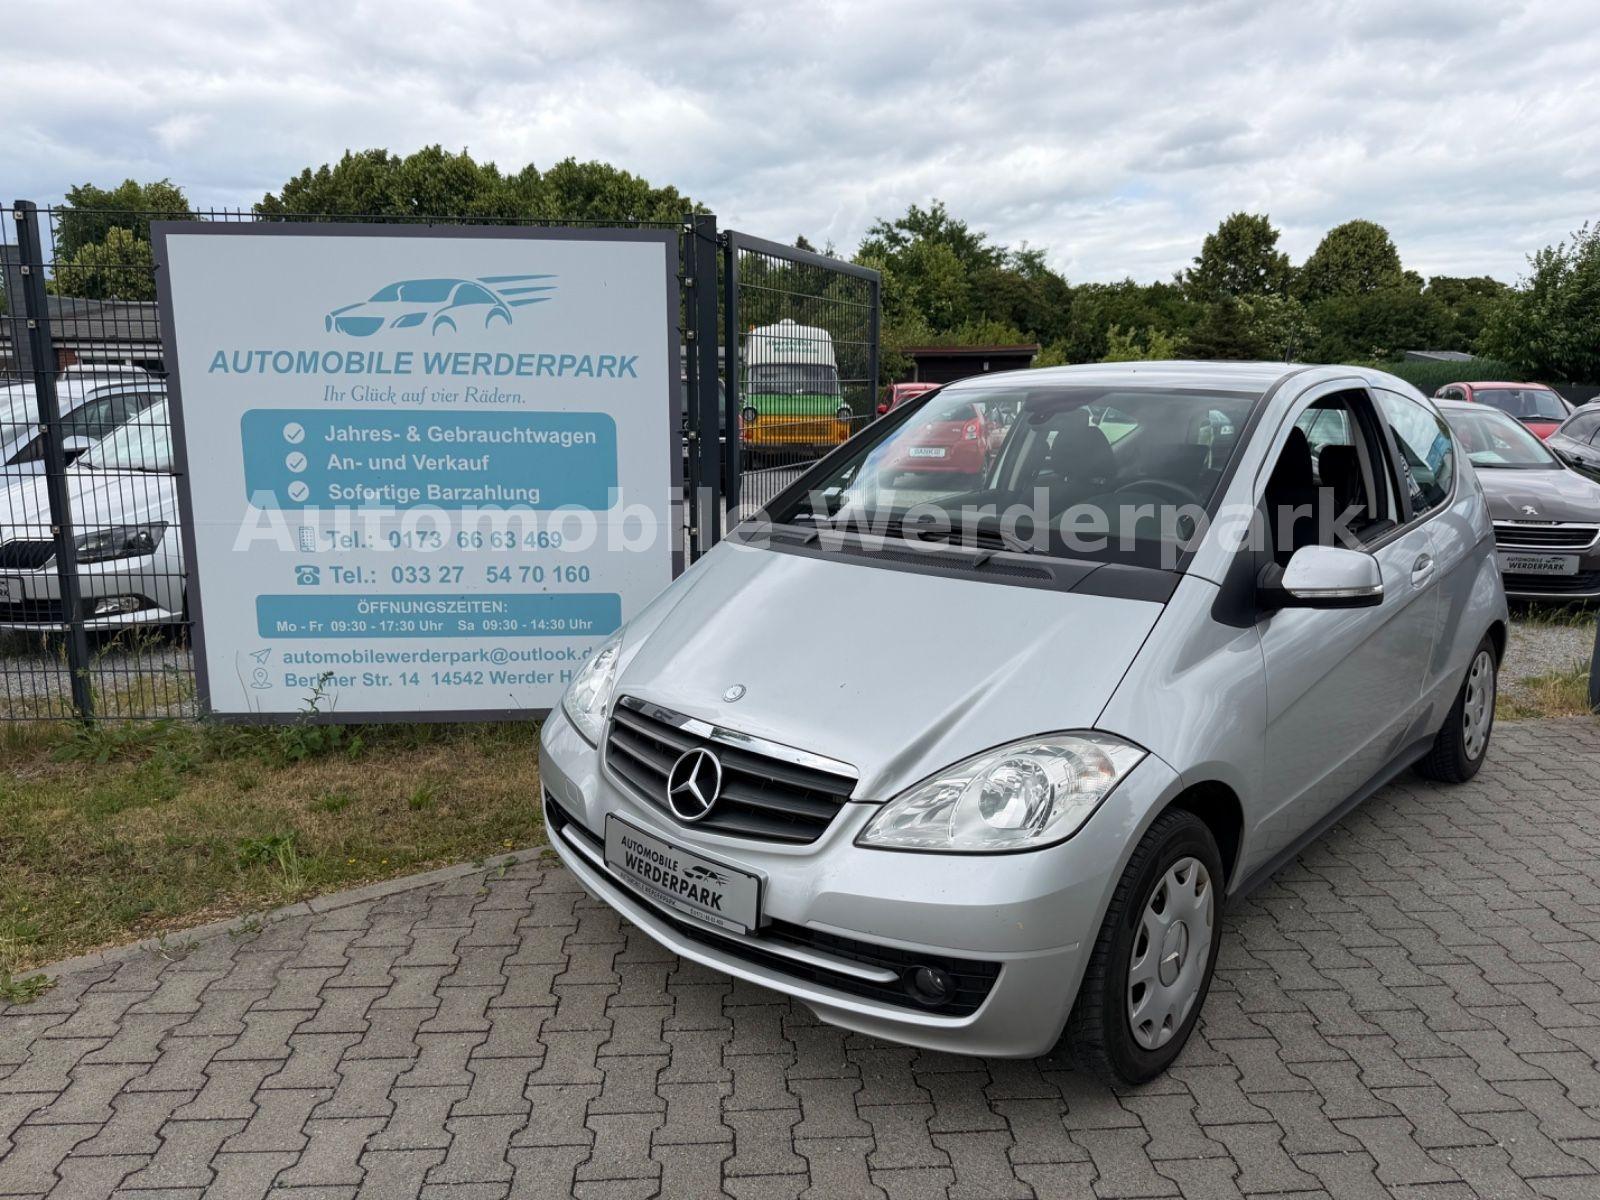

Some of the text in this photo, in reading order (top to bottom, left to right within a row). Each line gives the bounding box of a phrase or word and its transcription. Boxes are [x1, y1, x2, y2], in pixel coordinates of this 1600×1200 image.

[207, 350, 640, 378] AUTOMOBILE WERDERPARK
[323, 385, 526, 406] Ihr Glück auf vier Rädern.
[324, 425, 597, 448] Jahres- & Gebrauchtwagen
[326, 454, 491, 472] An- und Verkauf
[328, 484, 540, 504] Sofortige Barzahlung
[326, 530, 563, 549] Tel.: 0173 66 63 469
[329, 565, 591, 584] Tel.: 033 27 54 70 160
[1508, 562, 1565, 570] WERDERPARK
[357, 599, 509, 614] ÖFFNUNGSZEITEN:
[276, 621, 297, 632] Mo
[309, 621, 324, 632] Fr
[331, 620, 367, 632] 09:30
[379, 620, 415, 631] 17:30
[419, 620, 444, 631] Uhr
[457, 620, 475, 631] Sa
[482, 619, 518, 631] 09:30
[530, 619, 566, 630] 14:30
[569, 618, 593, 630] Uhr
[283, 646, 593, 665] automobilewerderpark@outlook.d
[362, 672, 393, 687] Str.
[399, 672, 420, 686] 14
[431, 671, 484, 686] 14542
[489, 670, 554, 685] Werder
[621, 835, 679, 873] AUTOMOBILE
[625, 851, 724, 911] WERDERPARK
